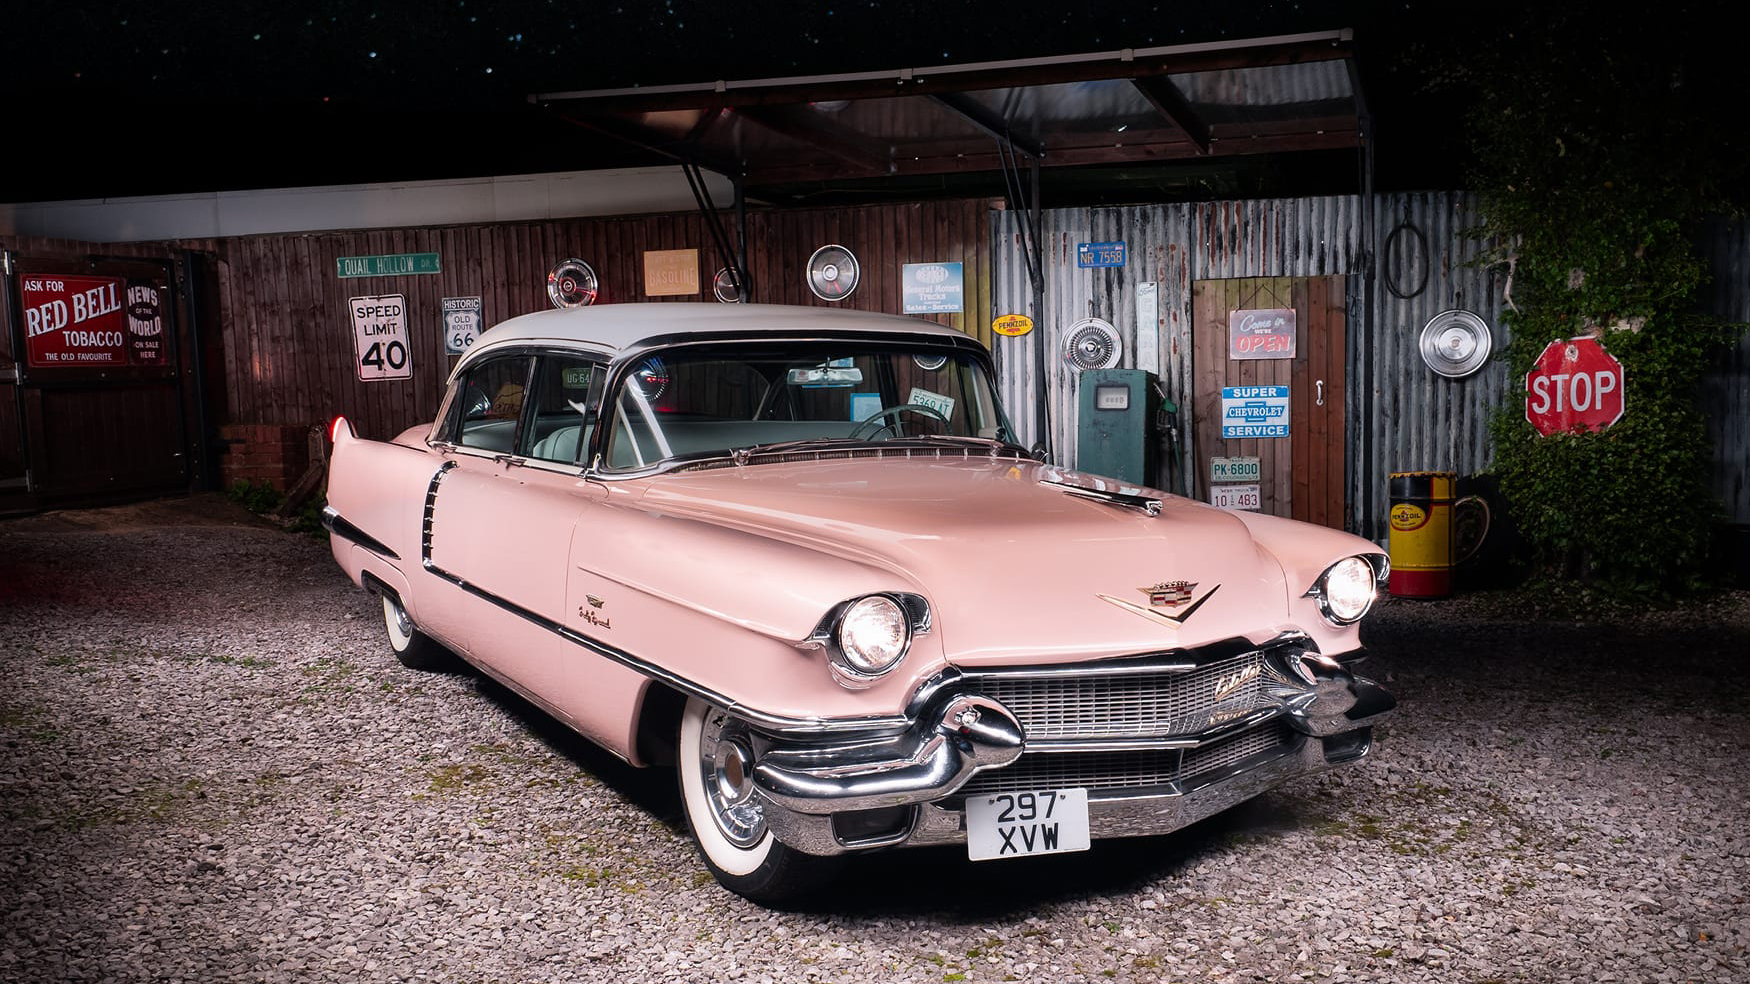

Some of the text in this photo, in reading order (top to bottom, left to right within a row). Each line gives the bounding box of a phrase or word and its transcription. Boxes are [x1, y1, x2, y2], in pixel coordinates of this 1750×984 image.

[1080, 250, 1122, 264] NR 7558
[345, 259, 372, 275] QUAIL
[377, 257, 414, 274] HOLLOW
[24, 281, 65, 292] ASK FOR
[127, 286, 158, 307] NEWS
[26, 283, 121, 338] RED BELL
[357, 305, 401, 318] SPEED
[444, 299, 479, 310] HISTORIC
[128, 313, 161, 337] WORLD
[454, 315, 471, 324] OLD
[998, 320, 1029, 329] PENNZOIL
[1240, 314, 1286, 332] Come in
[364, 323, 398, 336] LIMIT
[451, 323, 473, 331] ROUTE
[63, 331, 123, 347] TOBACCO
[145, 341, 159, 349] SALE
[453, 332, 475, 347] 66
[1235, 334, 1291, 353] OPEN
[45, 353, 112, 361] THE OLD FAVOURITE
[140, 351, 156, 359] HERE
[361, 341, 406, 371] 40
[1233, 387, 1277, 398] SUPER
[1532, 370, 1616, 414] STOP
[1229, 407, 1283, 417] CHEVROLET
[1228, 426, 1285, 436] SERVICE
[1215, 495, 1227, 508] 10
[1238, 494, 1258, 506] 483
[996, 791, 1057, 823] 297
[998, 822, 1059, 855] XVW
